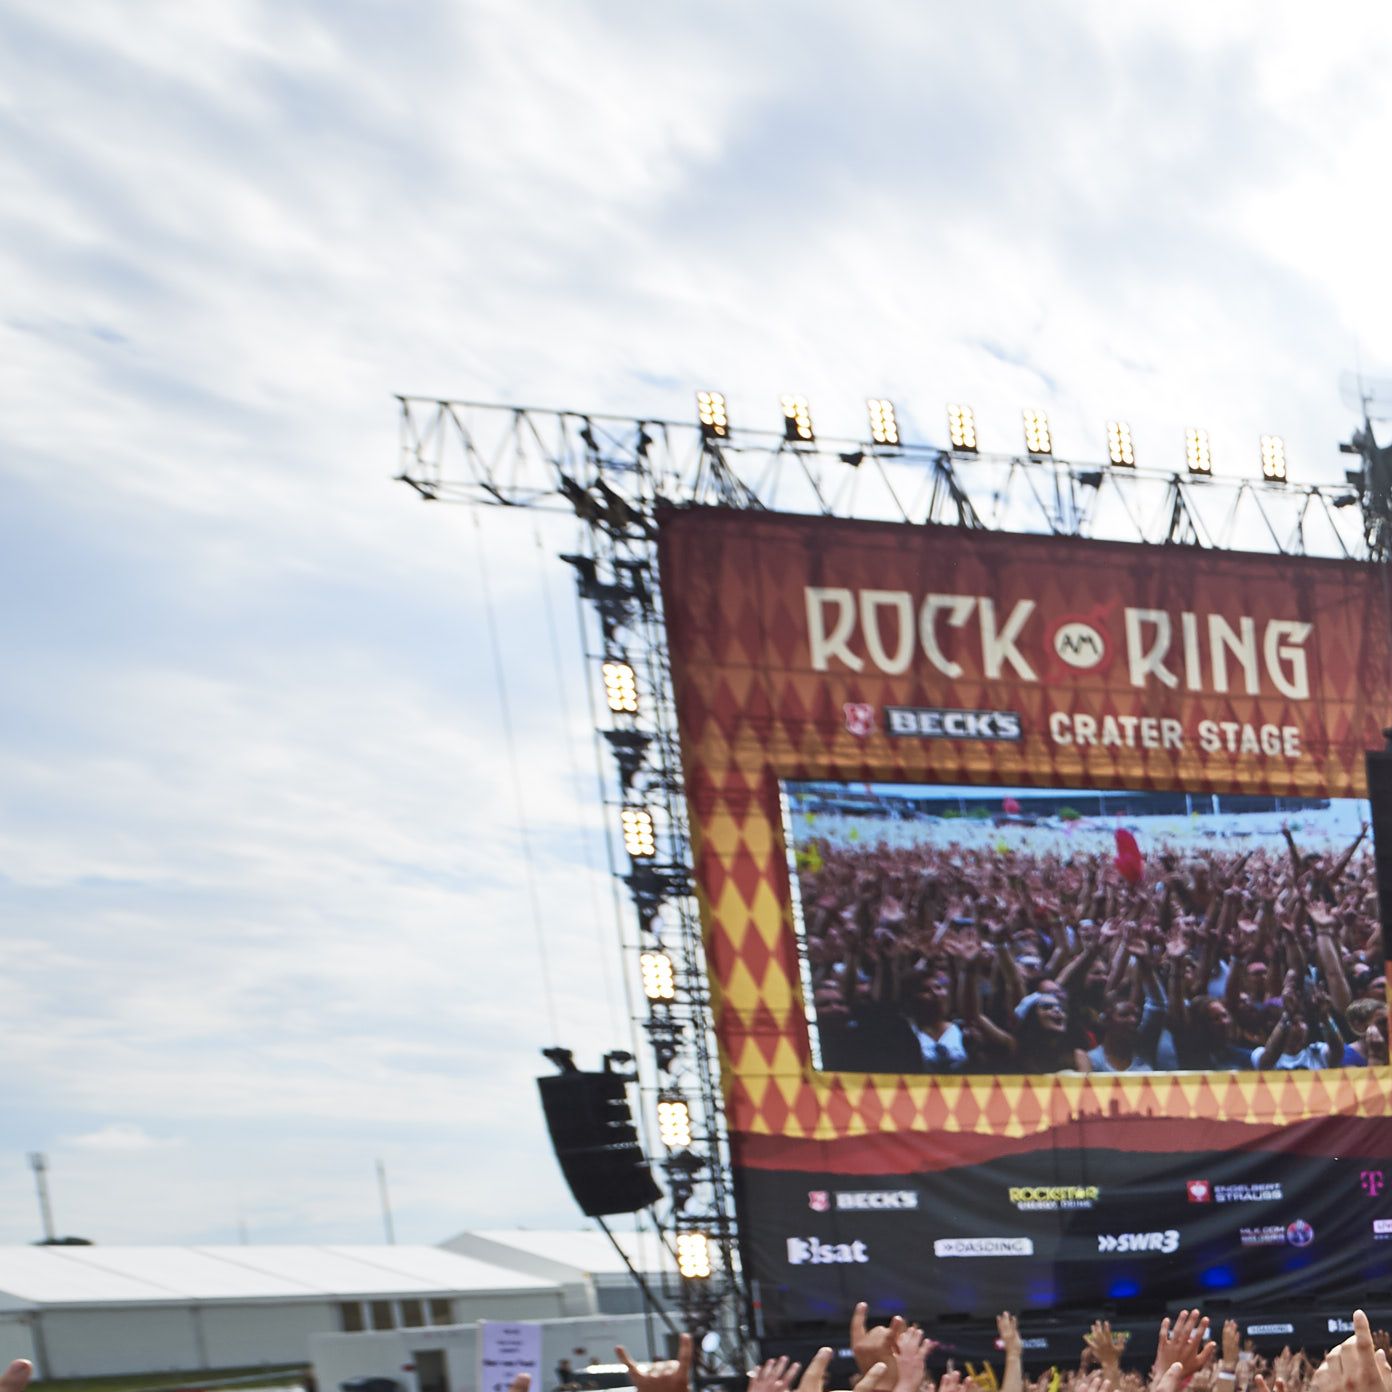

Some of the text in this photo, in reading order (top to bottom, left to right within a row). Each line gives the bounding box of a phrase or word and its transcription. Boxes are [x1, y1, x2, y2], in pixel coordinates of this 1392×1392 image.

[804, 586, 1039, 683] ROCK
[1124, 606, 1314, 701] RING
[888, 709, 1021, 740] BECK'S
[1050, 711, 1301, 758] CRATER STAGE
[837, 1191, 918, 1209] BECK'S
[1009, 1186, 1098, 1202] ROCKSTAR
[1215, 1191, 1283, 1202] STRAUSS
[1117, 1230, 1180, 1254] SWR3
